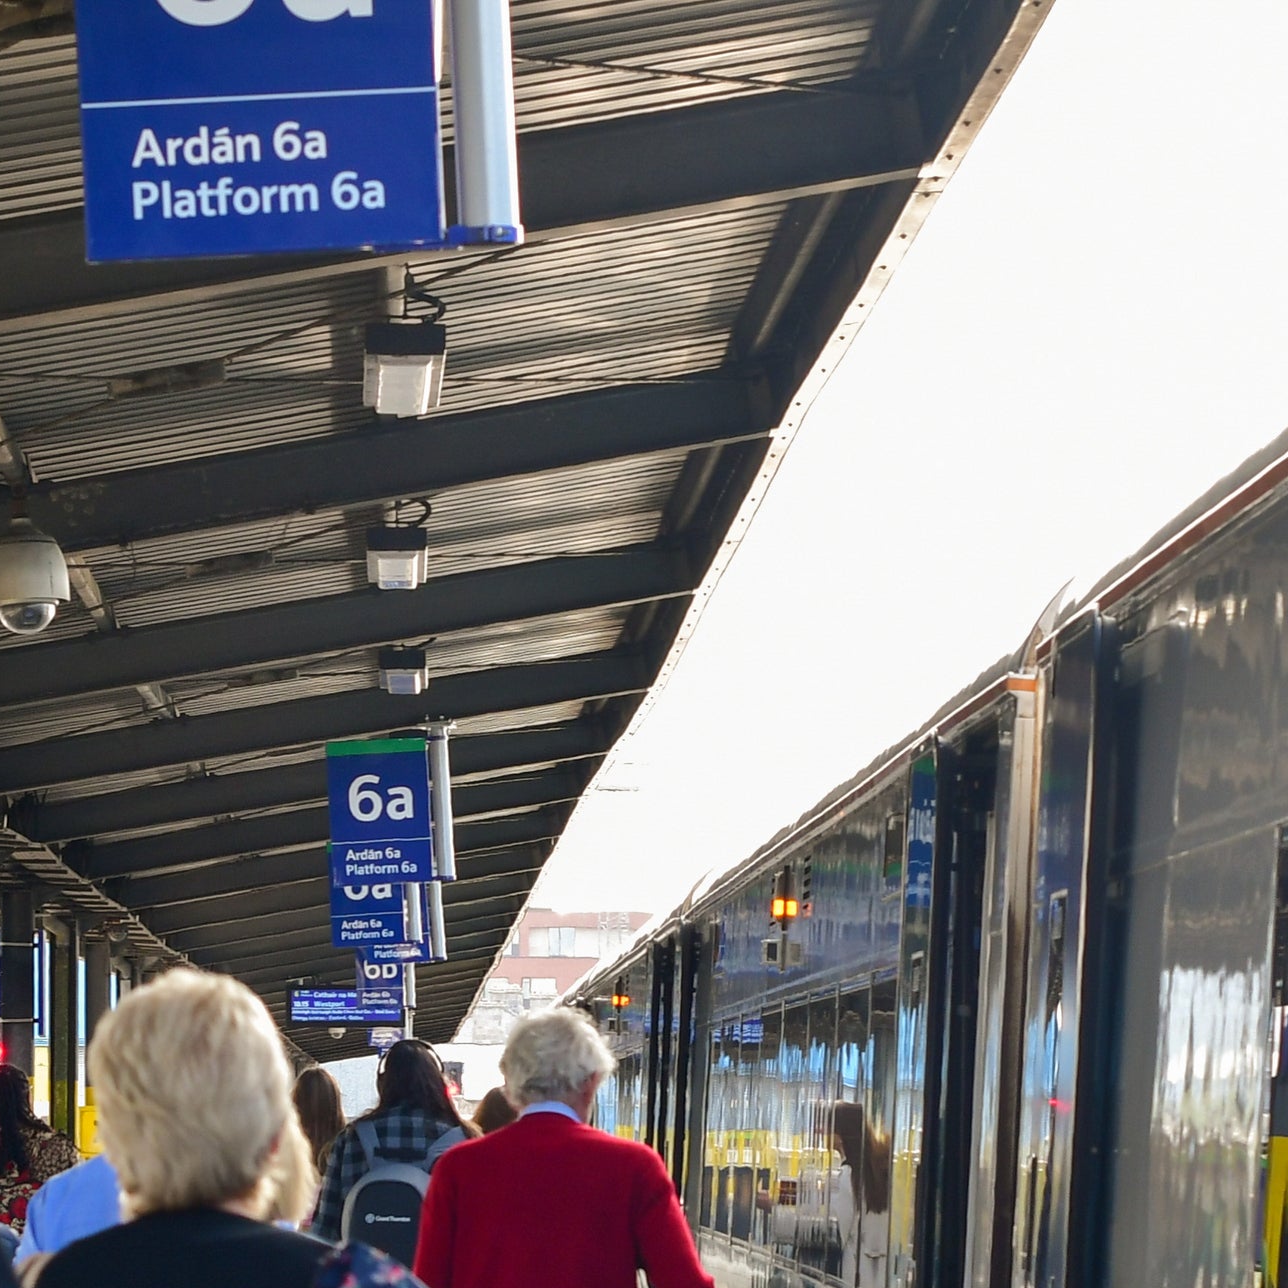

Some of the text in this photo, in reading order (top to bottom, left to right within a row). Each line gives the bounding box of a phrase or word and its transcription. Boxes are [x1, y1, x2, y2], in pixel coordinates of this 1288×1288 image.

[132, 121, 327, 168] Ardán 6a
[132, 171, 386, 220] Platform 6a
[347, 774, 415, 822] 6a
[345, 847, 401, 861] Ardán 6a
[345, 861, 418, 876] Platform 6a
[341, 919, 382, 930] Ardán 6a
[341, 929, 394, 940] Platform 6a
